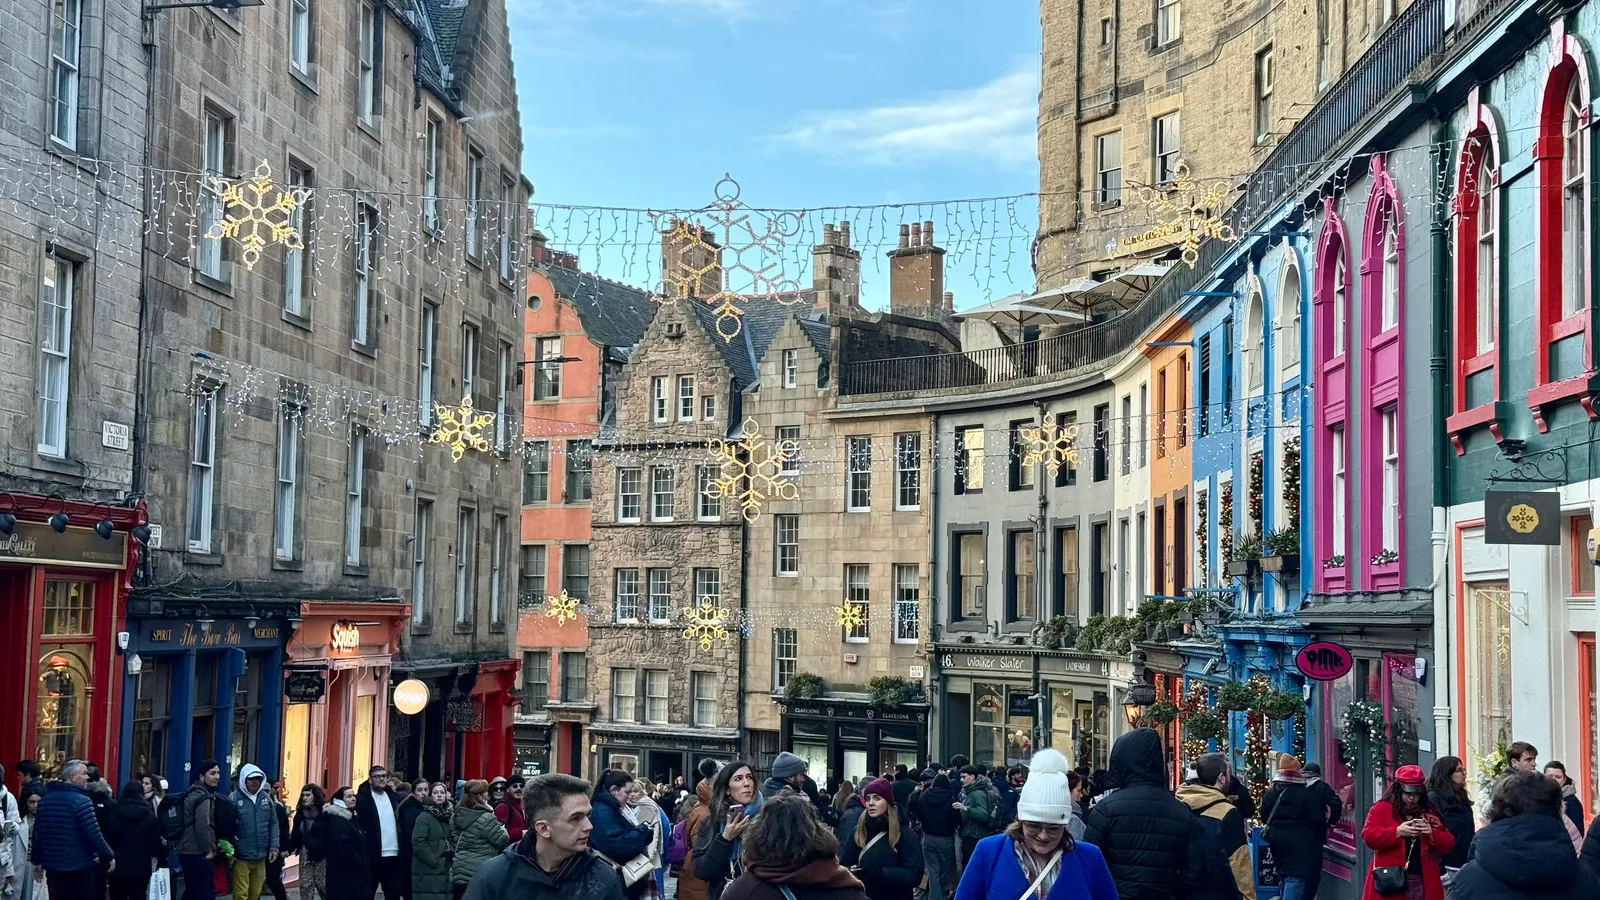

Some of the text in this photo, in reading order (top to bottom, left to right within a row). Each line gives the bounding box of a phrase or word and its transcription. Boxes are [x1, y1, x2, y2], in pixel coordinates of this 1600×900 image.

[105, 422, 127, 436] VICTORIA
[106, 435, 124, 447] STREET
[152, 629, 172, 641] SPIRIT
[180, 623, 197, 646] The
[224, 622, 240, 645] Bar
[254, 628, 279, 639] MERCHANT
[332, 623, 360, 651] Squish
[967, 656, 1024, 669] Walker Slater
[1065, 661, 1091, 673] LADIESWEAR
[395, 690, 425, 703] Squish
[725, 744, 737, 752] 89
